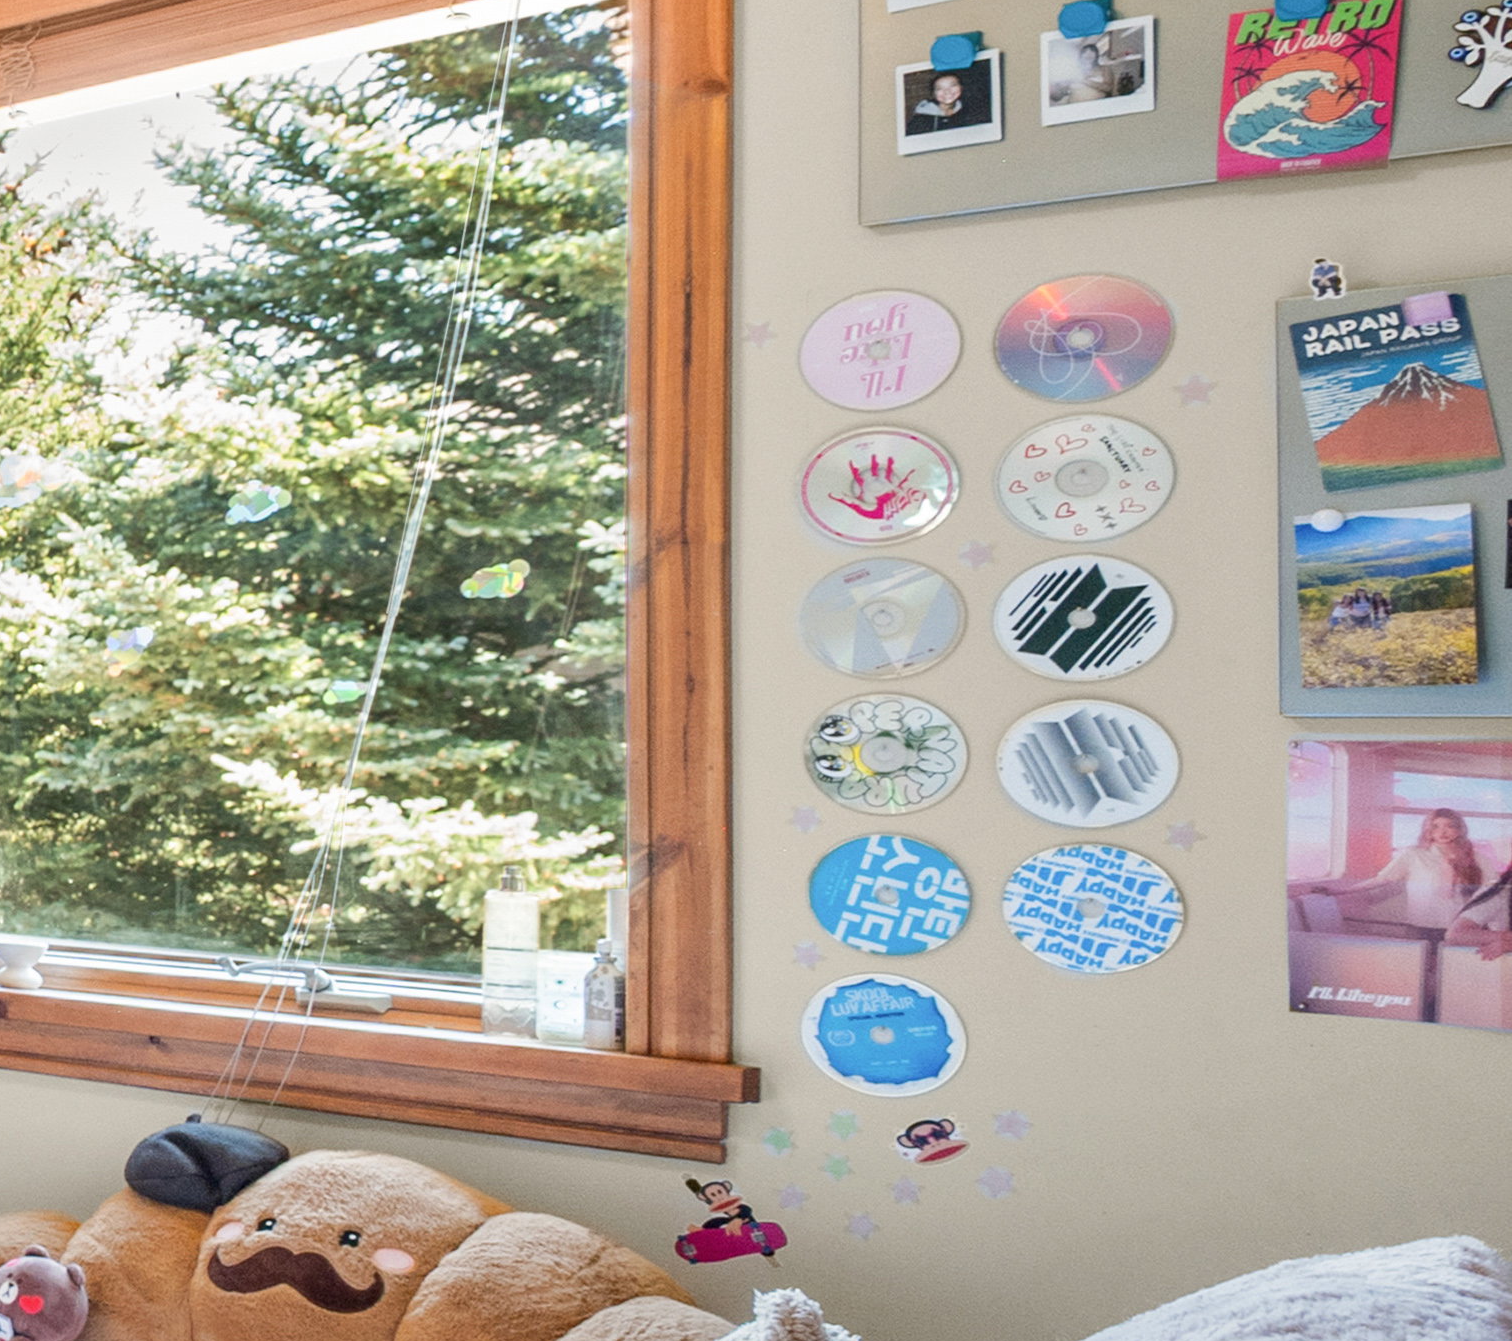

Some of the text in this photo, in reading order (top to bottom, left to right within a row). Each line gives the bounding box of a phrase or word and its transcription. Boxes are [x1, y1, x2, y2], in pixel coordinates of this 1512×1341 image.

[1273, 29, 1347, 56] Wave
[1302, 312, 1399, 341] JAPAN
[1304, 317, 1461, 358] RAIL PASS
[1074, 877, 1146, 908] HAPPY
[1011, 902, 1082, 933] HAPPY
[1094, 913, 1169, 944] HAPPY
[1033, 937, 1104, 969] HAPPY
[830, 996, 916, 1017] LUV AFFAIR
[844, 987, 890, 1003] SKOOL
